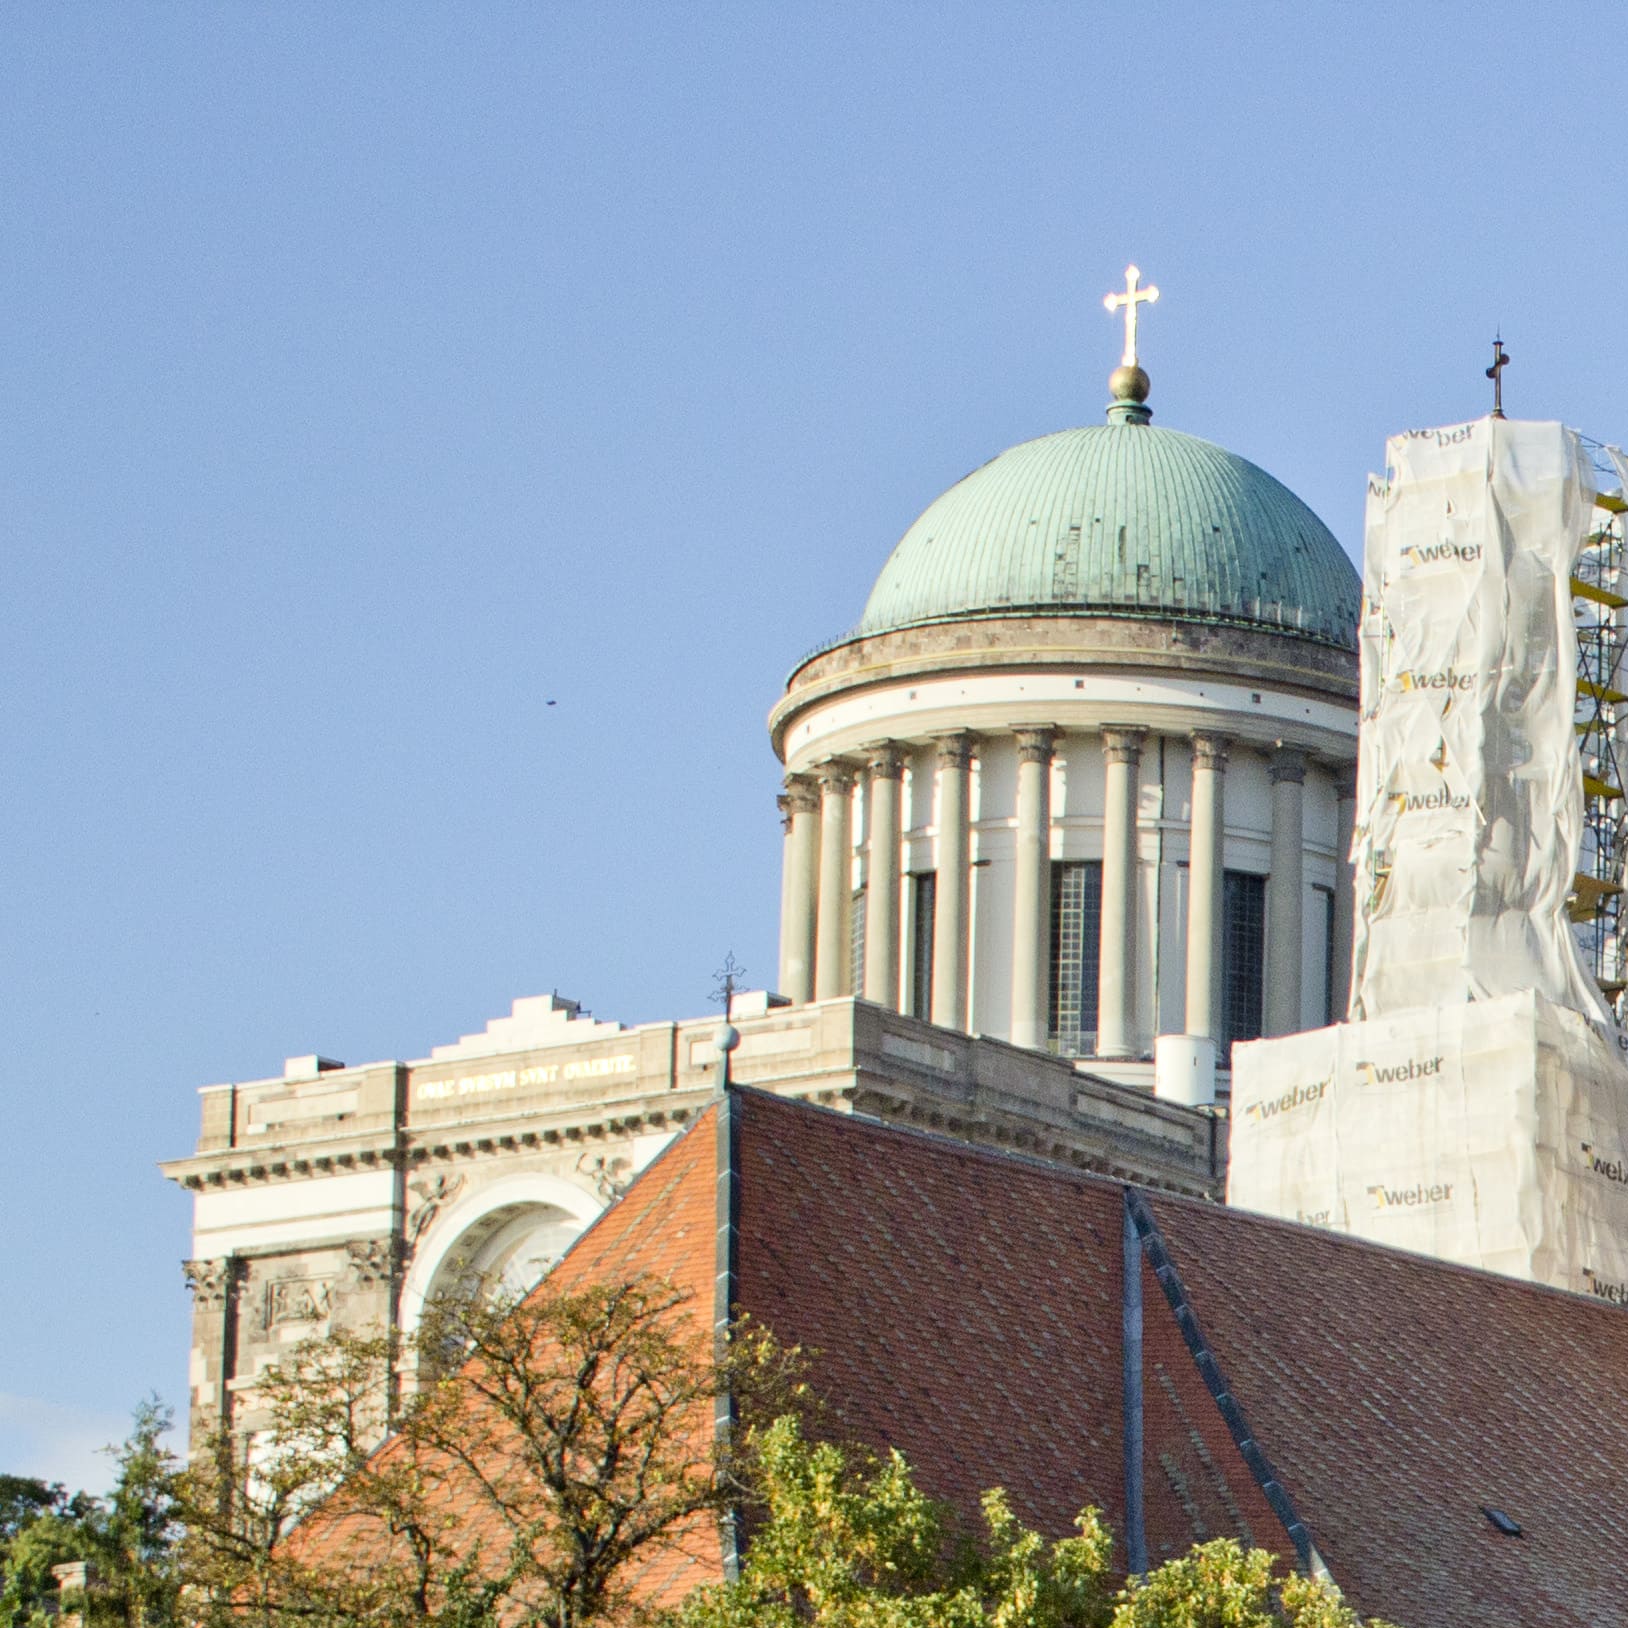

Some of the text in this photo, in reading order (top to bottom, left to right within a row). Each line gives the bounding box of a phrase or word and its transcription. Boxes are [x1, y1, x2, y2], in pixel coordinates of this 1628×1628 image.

[1374, 1056, 1444, 1083] weber
[1259, 1080, 1328, 1119] weber
[1383, 1183, 1454, 1207] weber
